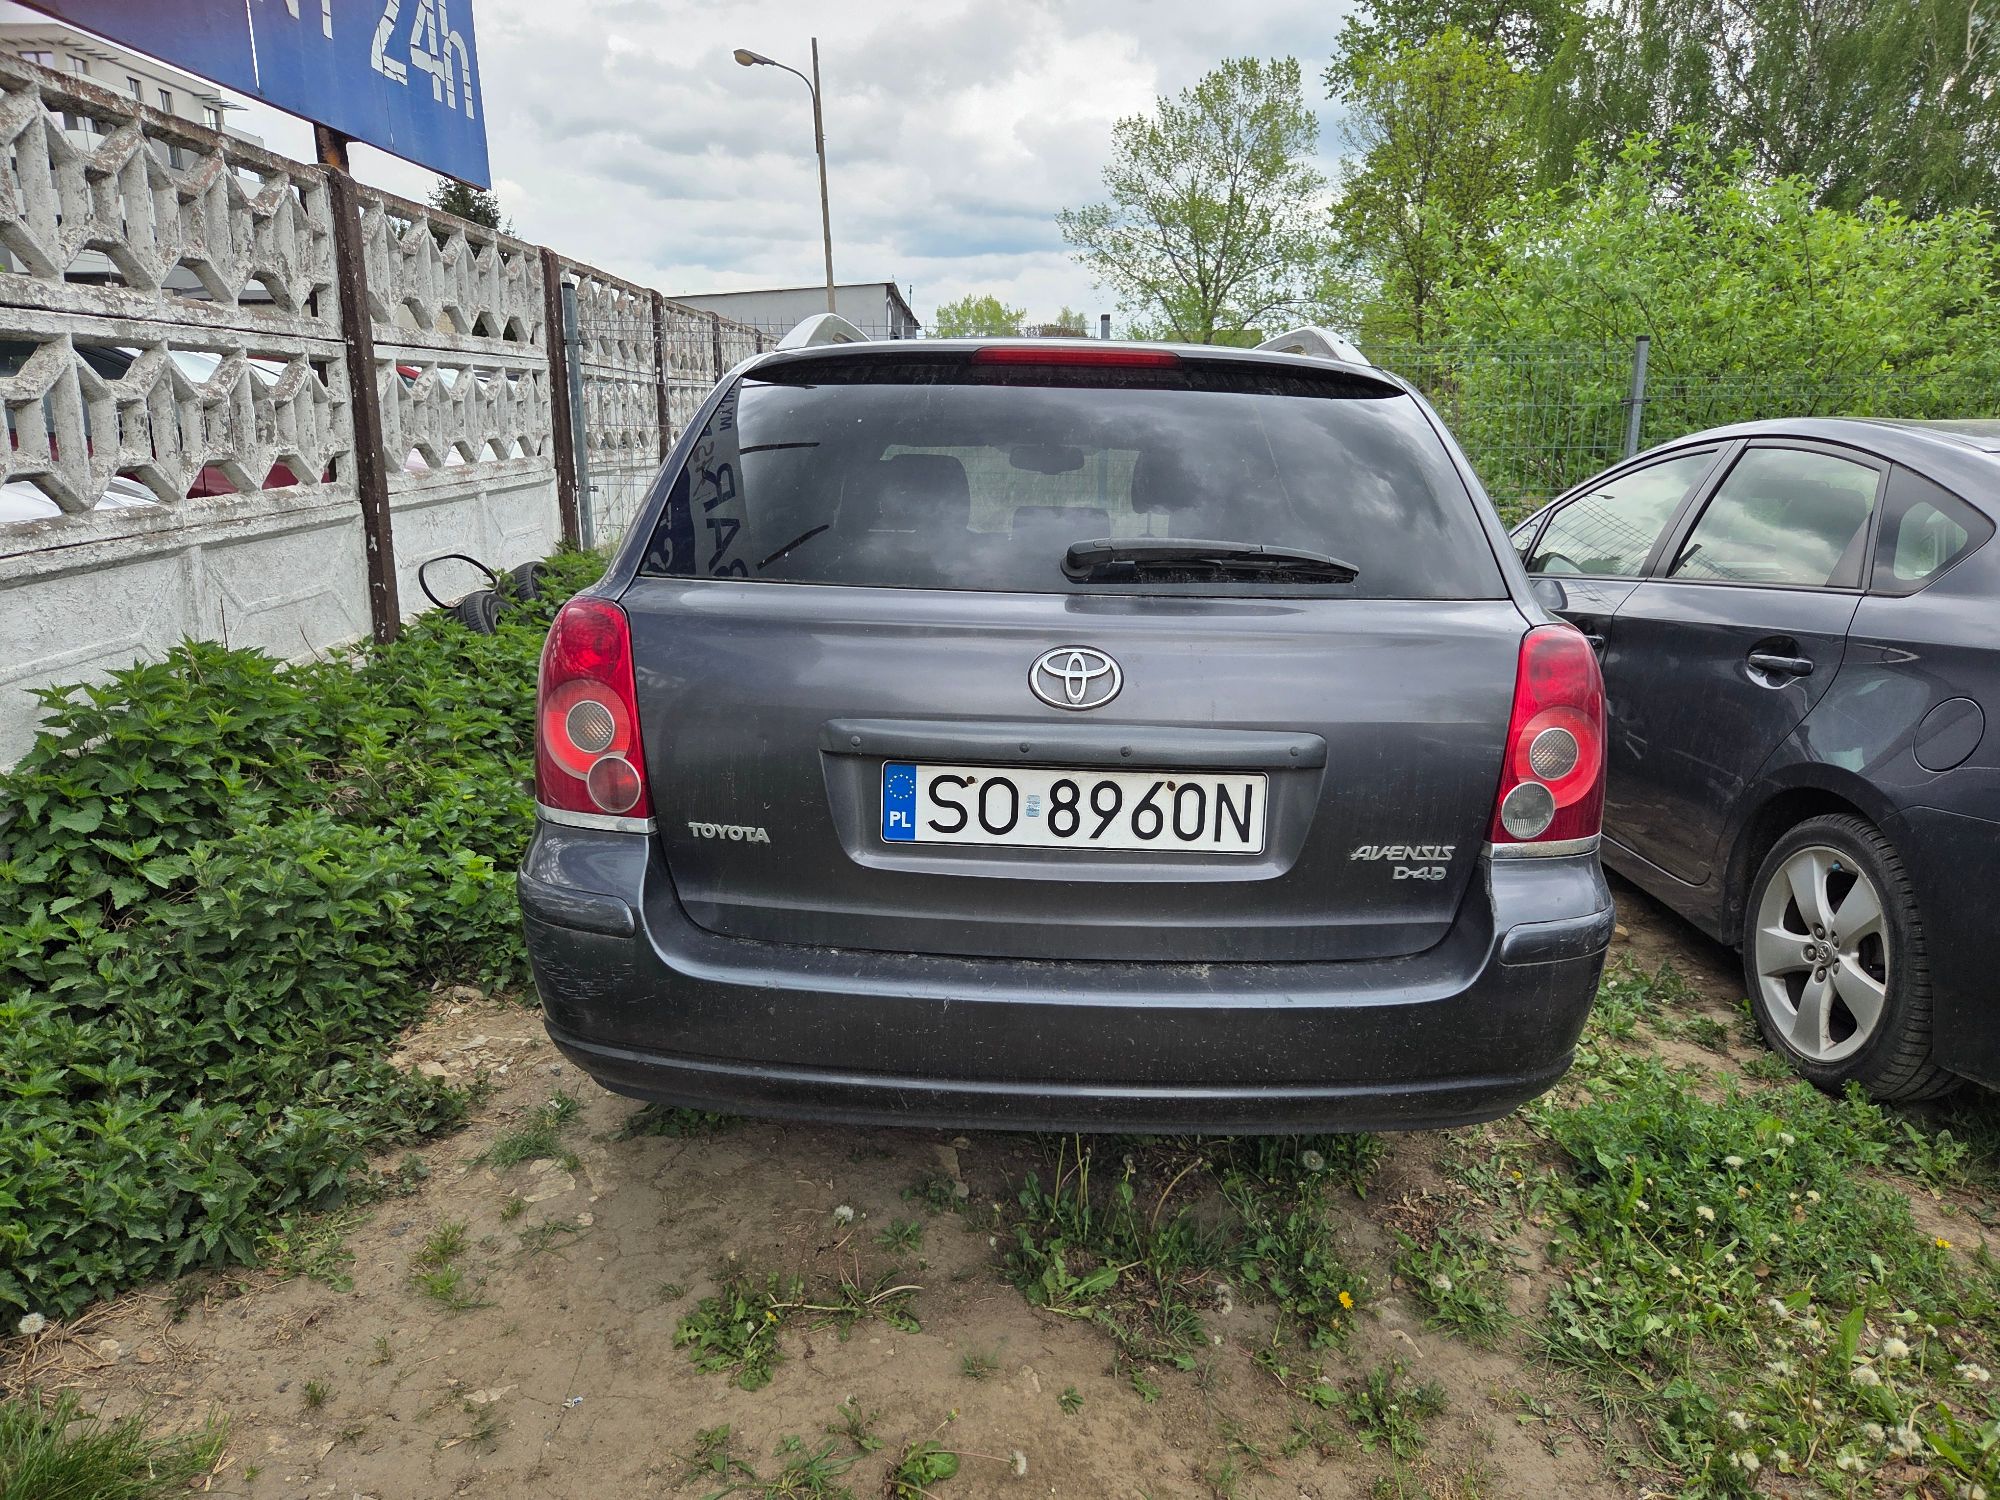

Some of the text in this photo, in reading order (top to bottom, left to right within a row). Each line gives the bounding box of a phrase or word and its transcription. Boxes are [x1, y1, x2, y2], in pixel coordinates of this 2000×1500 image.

[371, 0, 475, 119] 24h
[889, 811, 911, 828] PL
[927, 774, 1253, 843] SO 8960N
[687, 821, 771, 843] TOYOTA
[1350, 845, 1456, 861] AVENSIS
